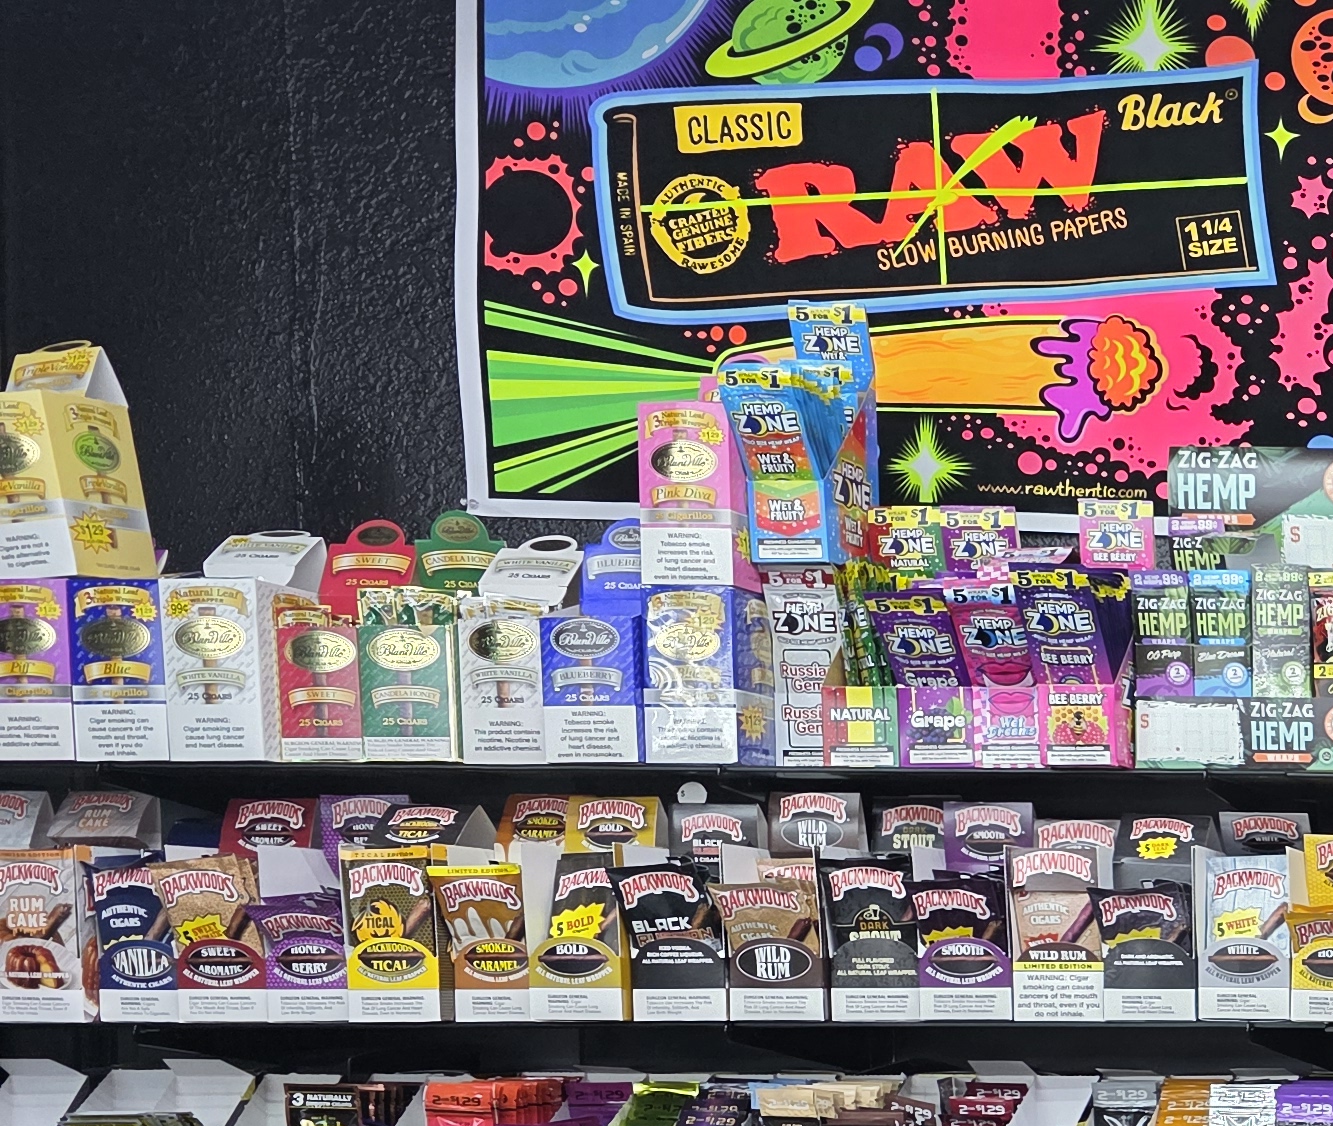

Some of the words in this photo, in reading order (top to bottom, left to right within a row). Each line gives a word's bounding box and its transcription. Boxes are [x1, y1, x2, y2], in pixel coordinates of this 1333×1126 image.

[1118, 92, 1223, 131] Black
[687, 110, 793, 146] CLASSIC
[616, 172, 628, 204] MADE
[660, 179, 726, 205] AUTHENTIC
[756, 110, 1106, 263] RAW
[620, 206, 629, 221] IN
[669, 207, 730, 229] CRAFTED
[672, 218, 733, 239] GENUINE
[676, 227, 737, 251] FIBERS
[877, 239, 937, 269] SLOW
[950, 223, 1044, 258] BURNING
[1051, 208, 1127, 241] PAPERS
[1184, 222, 1195, 241] 1
[1201, 217, 1232, 236] 1/4
[622, 224, 633, 256] SPAIN
[1188, 237, 1238, 258] SIZE
[682, 238, 745, 272] RAWESOME
[804, 334, 859, 353] ZONE
[1178, 451, 1257, 468] ZIG-ZAG
[656, 489, 683, 502] Pink
[687, 489, 711, 501] Diva
[977, 480, 1147, 499] www.rawthentic.com
[1178, 473, 1256, 511] HEMP
[770, 511, 804, 521] FRUITY
[1049, 694, 1070, 705] BEE
[1071, 694, 1102, 705] BERRY
[1250, 701, 1314, 719] ZIG-ZAG
[830, 706, 890, 722] NATURAL
[911, 710, 965, 731] Grape
[1250, 721, 1313, 751] HEMP
[350, 864, 423, 898] BACKWOODS
[113, 946, 169, 975] VANILLA
[556, 944, 588, 956] BOLD
[754, 945, 791, 964] WILD
[371, 960, 410, 972] TICAL
[756, 961, 790, 979] RUM
